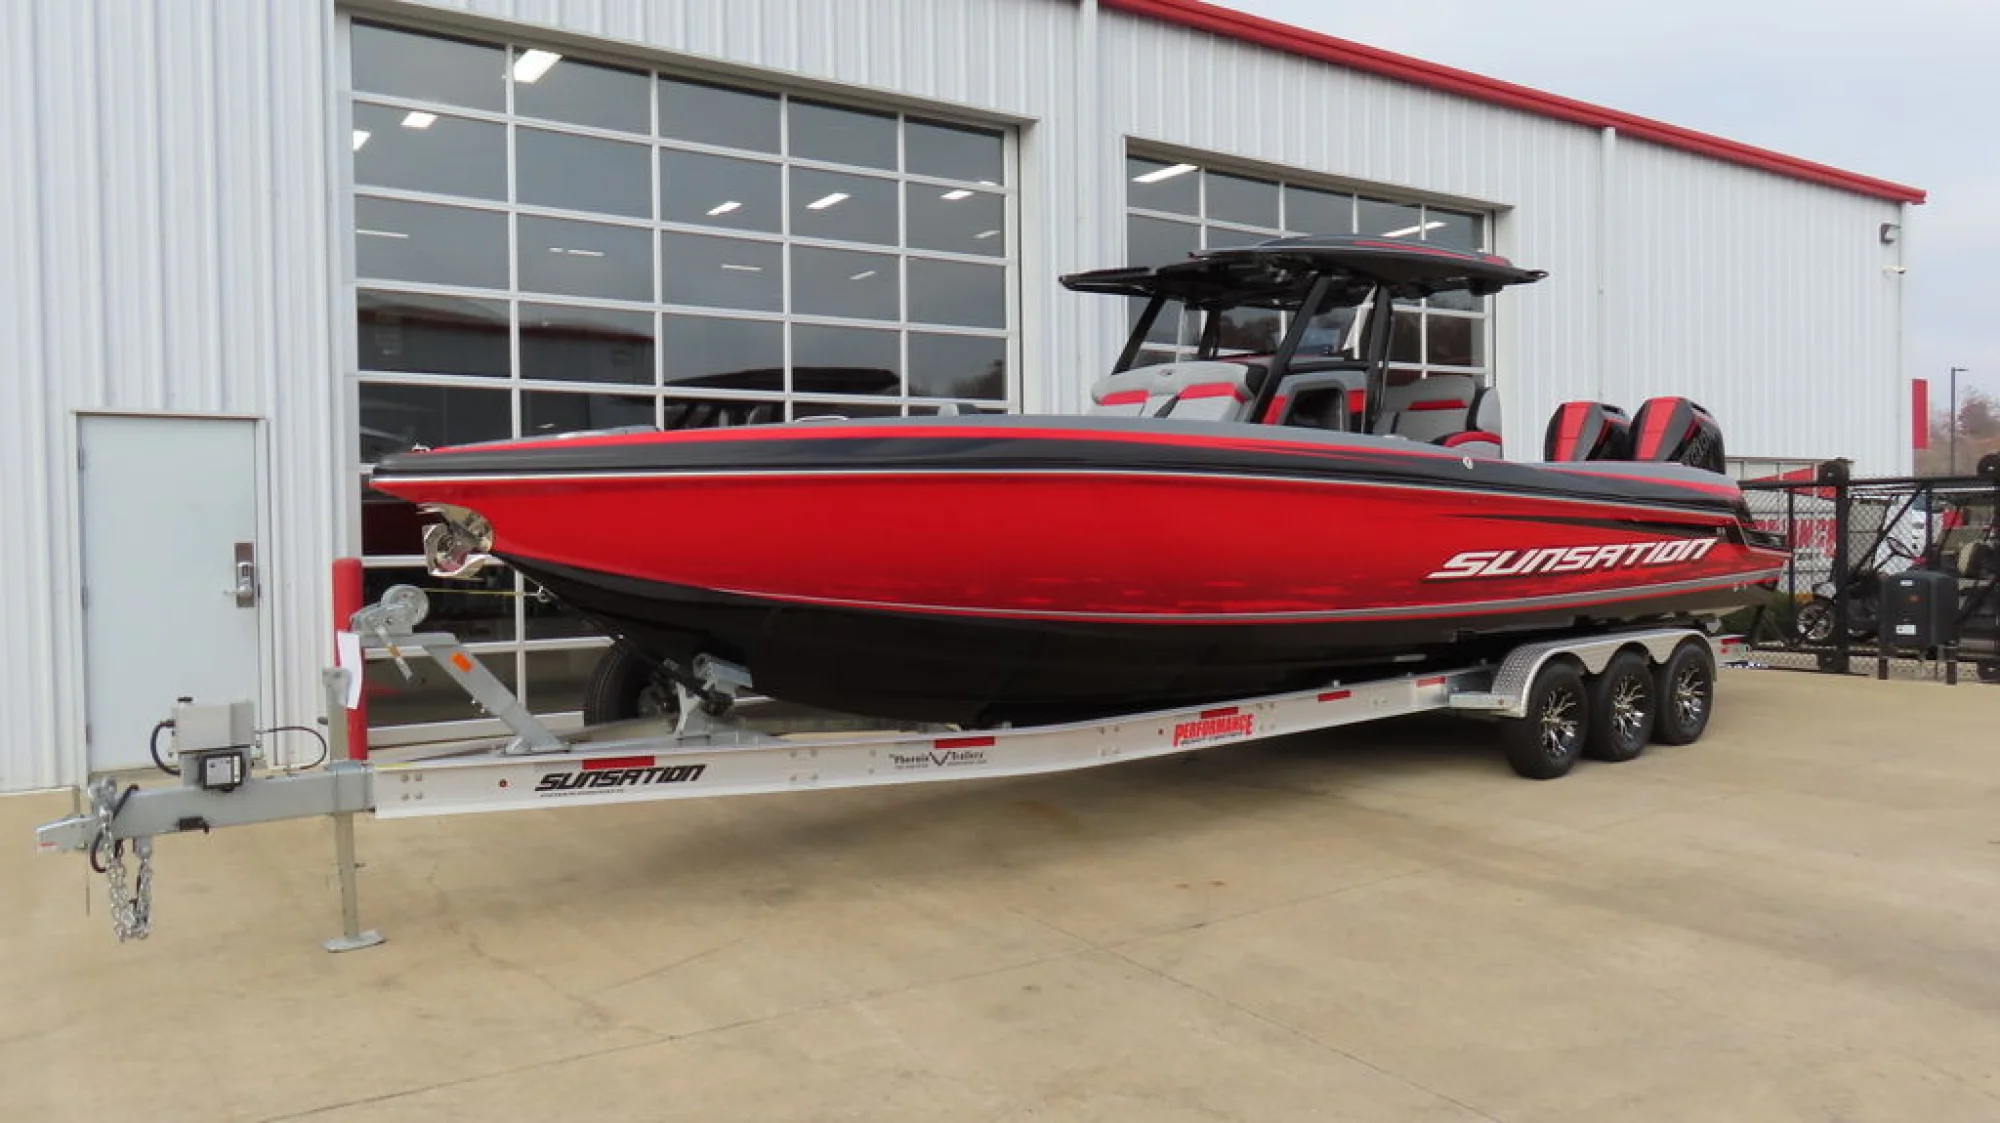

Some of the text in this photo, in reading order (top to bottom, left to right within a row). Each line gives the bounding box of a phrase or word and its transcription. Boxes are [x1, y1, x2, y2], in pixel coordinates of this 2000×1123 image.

[1426, 537, 1718, 580] SUNSATION
[1173, 714, 1253, 748] PERFORMANCE
[535, 764, 707, 792] SUNSATION
